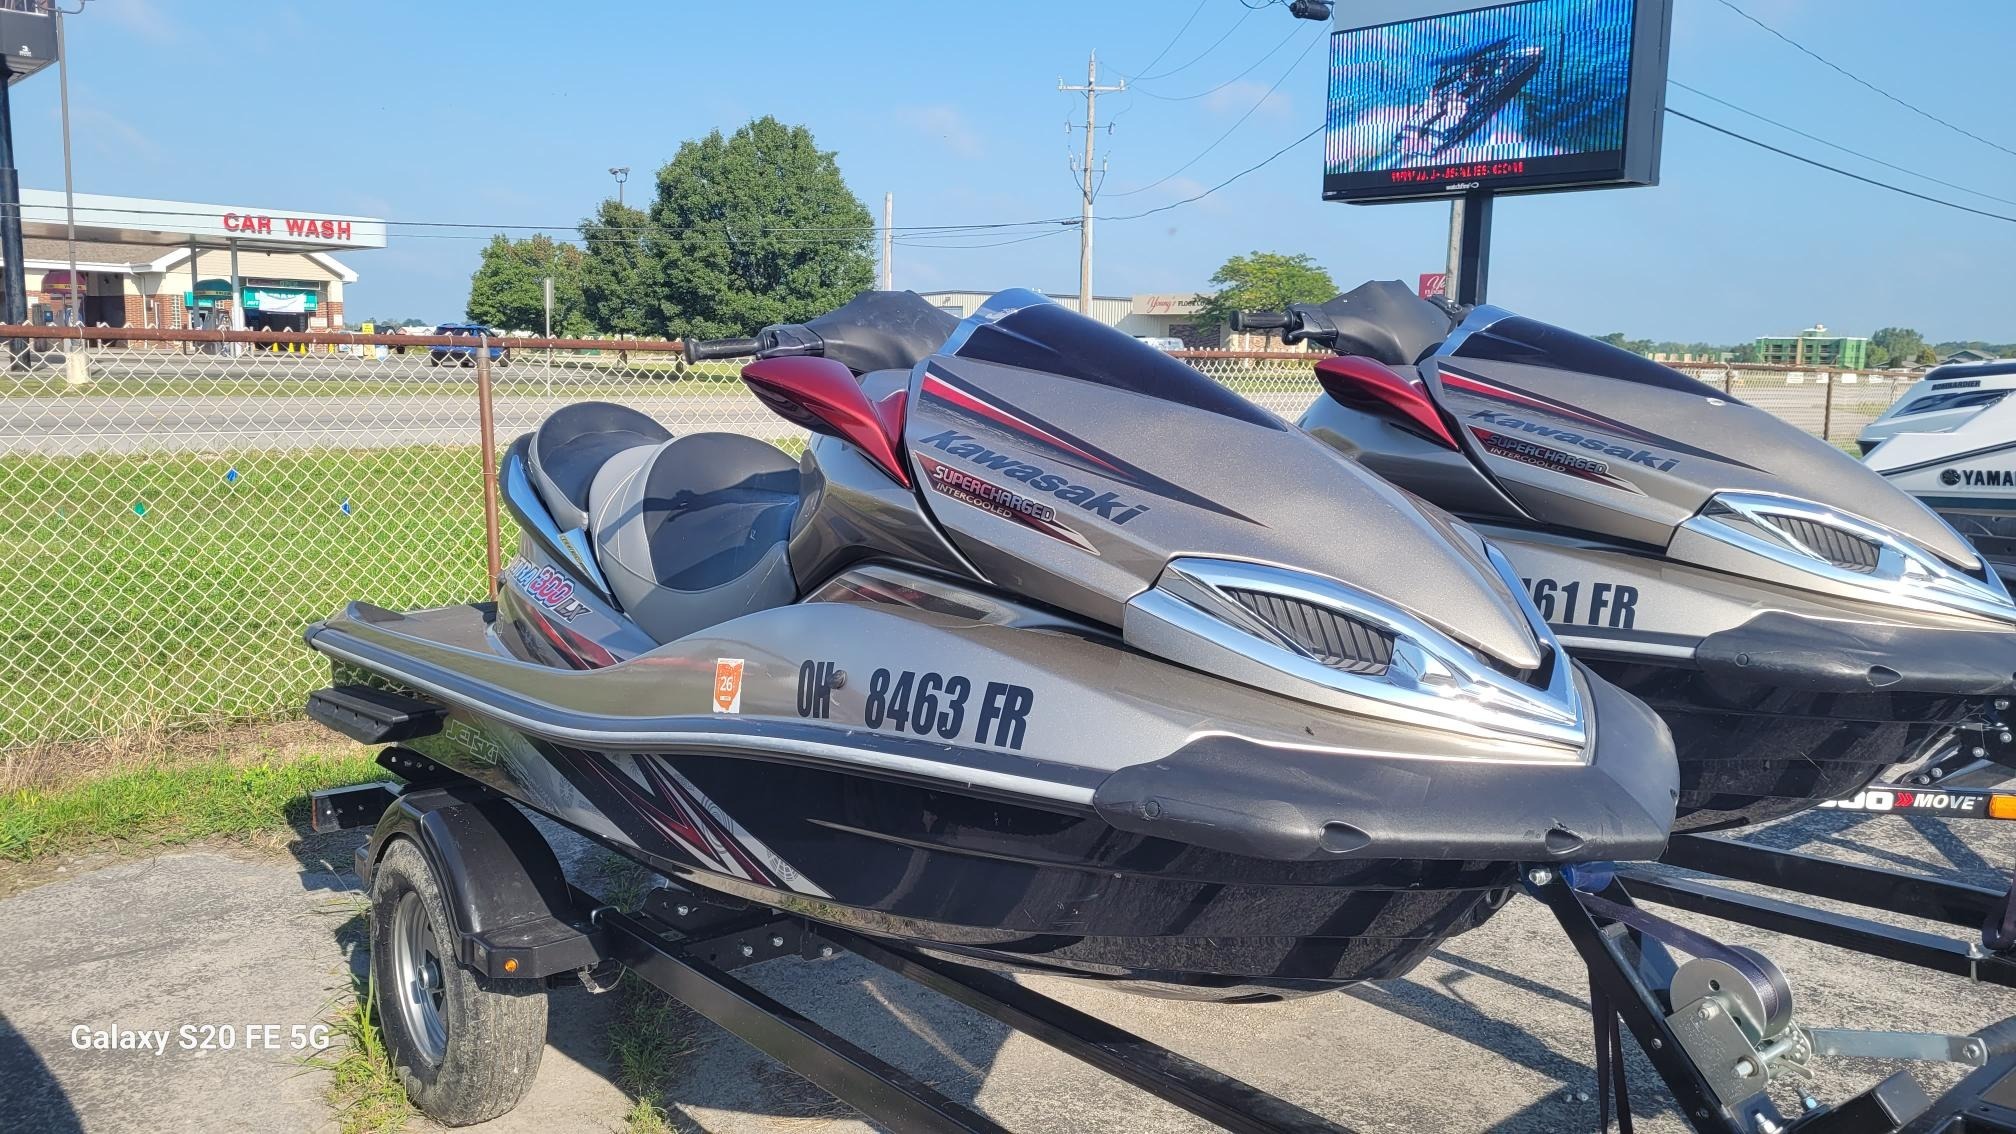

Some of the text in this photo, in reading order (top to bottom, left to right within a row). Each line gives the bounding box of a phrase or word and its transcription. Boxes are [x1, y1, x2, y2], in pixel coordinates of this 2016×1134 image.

[224, 213, 351, 240] CAR WASH
[1467, 409, 1680, 472] Kawasaki
[1489, 434, 1608, 474] SUPERCHARGED
[1491, 447, 1566, 472] INTERCOOLED
[918, 430, 1152, 525] Kawasaki
[933, 465, 1057, 522] SUPERCHARGED
[936, 482, 1012, 518] INTERCOOLED
[1962, 470, 2016, 486] YAMA
[528, 565, 575, 608] 300
[553, 598, 590, 621] LX
[1521, 578, 1639, 629] 61 FR
[720, 676, 733, 692] 26
[797, 660, 1034, 750] OH 8463 FR
